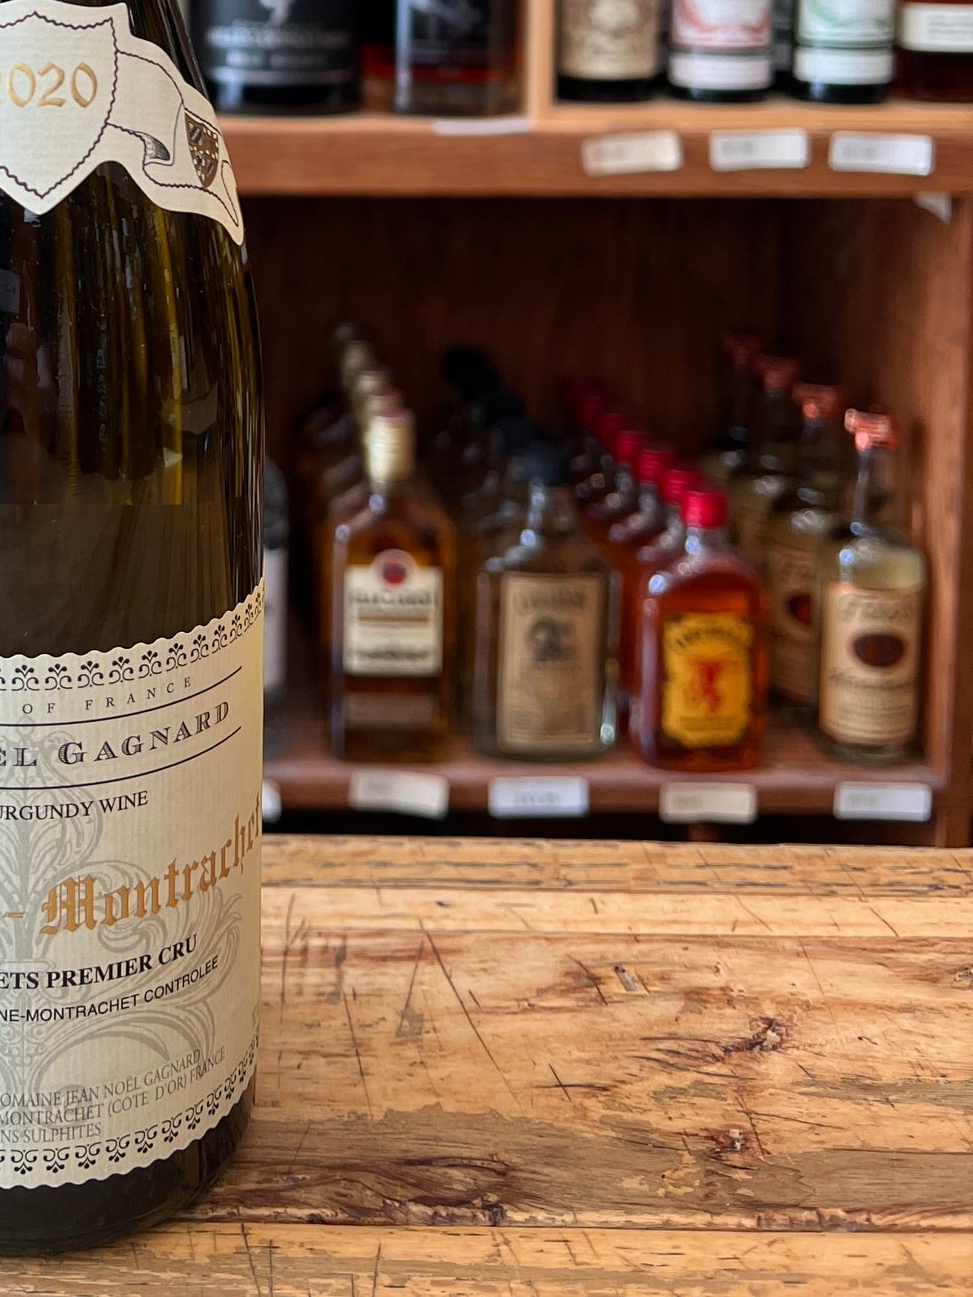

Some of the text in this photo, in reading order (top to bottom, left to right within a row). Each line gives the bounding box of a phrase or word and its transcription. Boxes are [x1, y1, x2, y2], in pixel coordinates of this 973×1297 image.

[22, 702, 57, 715] OF
[85, 676, 192, 711] FRANCE
[58, 701, 230, 766] GAGNARD
[98, 790, 149, 815] WINE
[45, 953, 153, 989] PREMIER
[157, 933, 198, 966] CRU
[143, 954, 220, 1004] CONTROLEE
[64, 1086, 100, 1109] JEAN
[144, 1048, 202, 1086] GAGNARD
[107, 1090, 148, 1119] (COTE
[155, 1070, 187, 1101] D'OR)
[189, 1045, 226, 1084] FRANCE
[23, 1122, 102, 1144] SULPHITES
